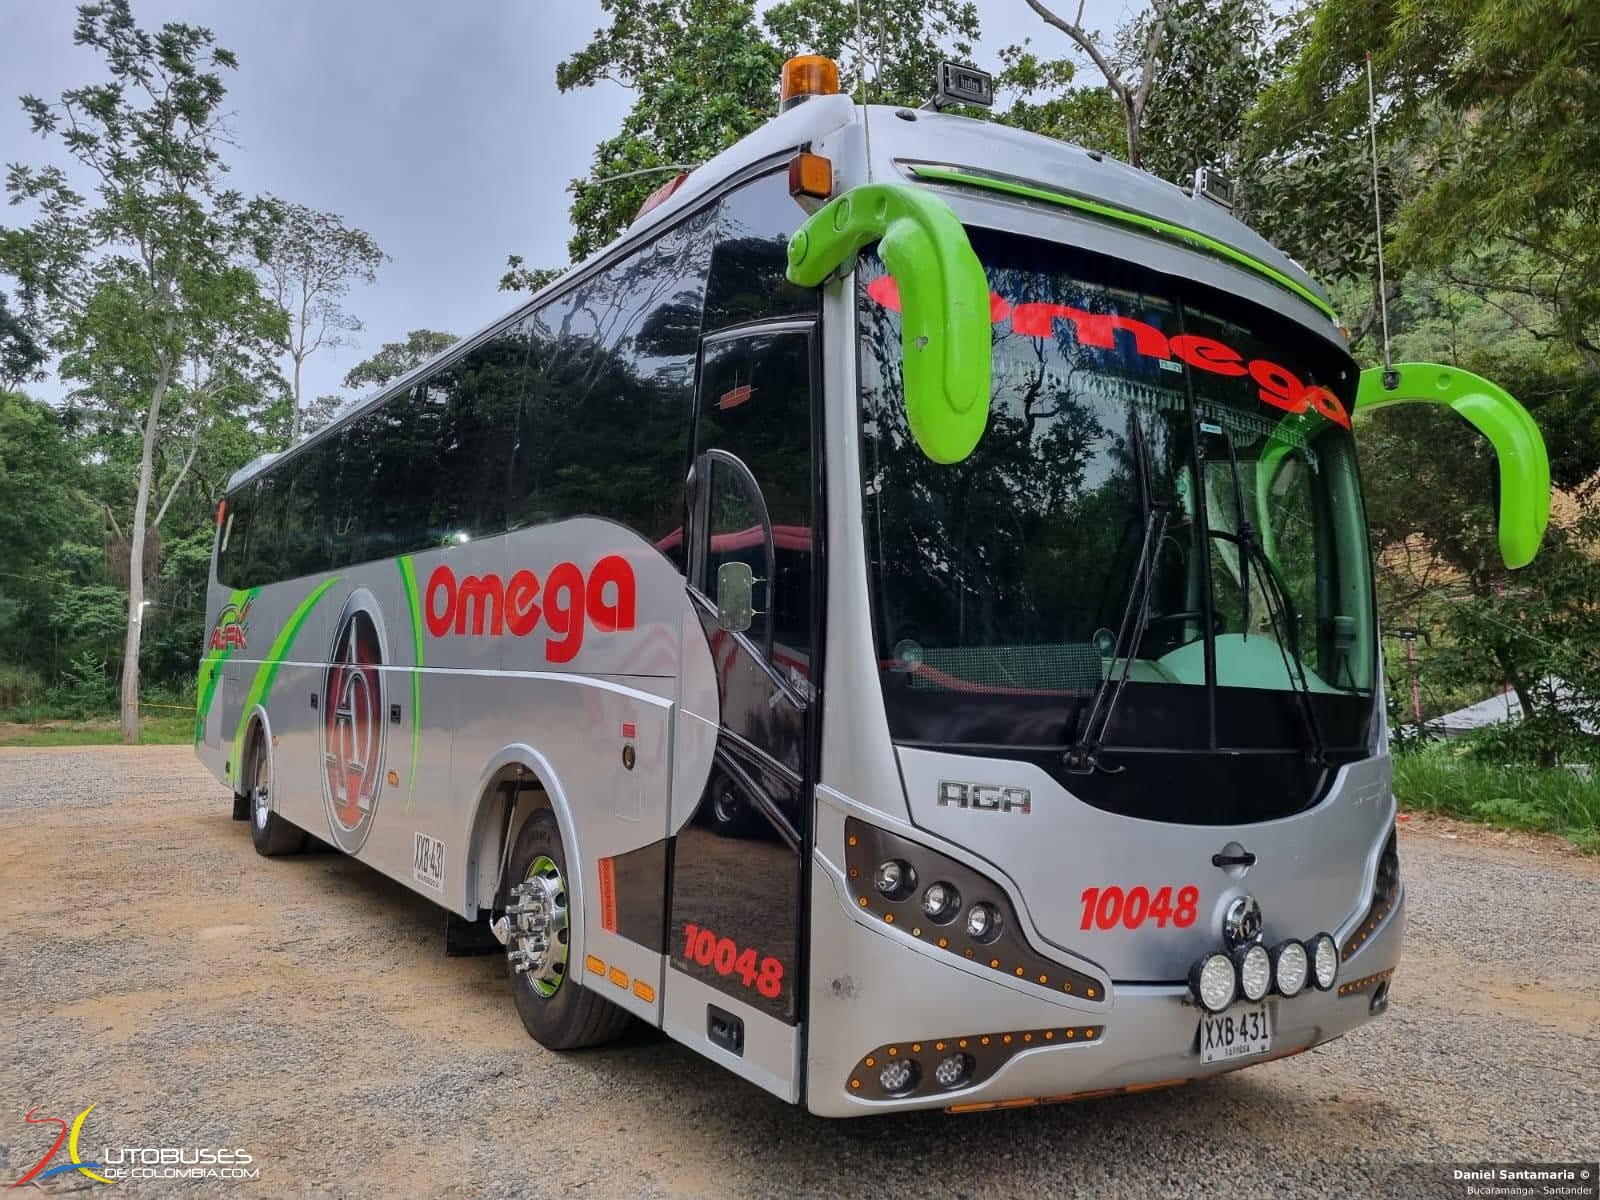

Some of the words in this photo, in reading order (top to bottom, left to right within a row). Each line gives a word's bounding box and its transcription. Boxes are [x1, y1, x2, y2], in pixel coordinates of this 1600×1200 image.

[938, 780, 1031, 814] AGA
[1080, 886, 1199, 930] 10048
[684, 923, 784, 998] 10048
